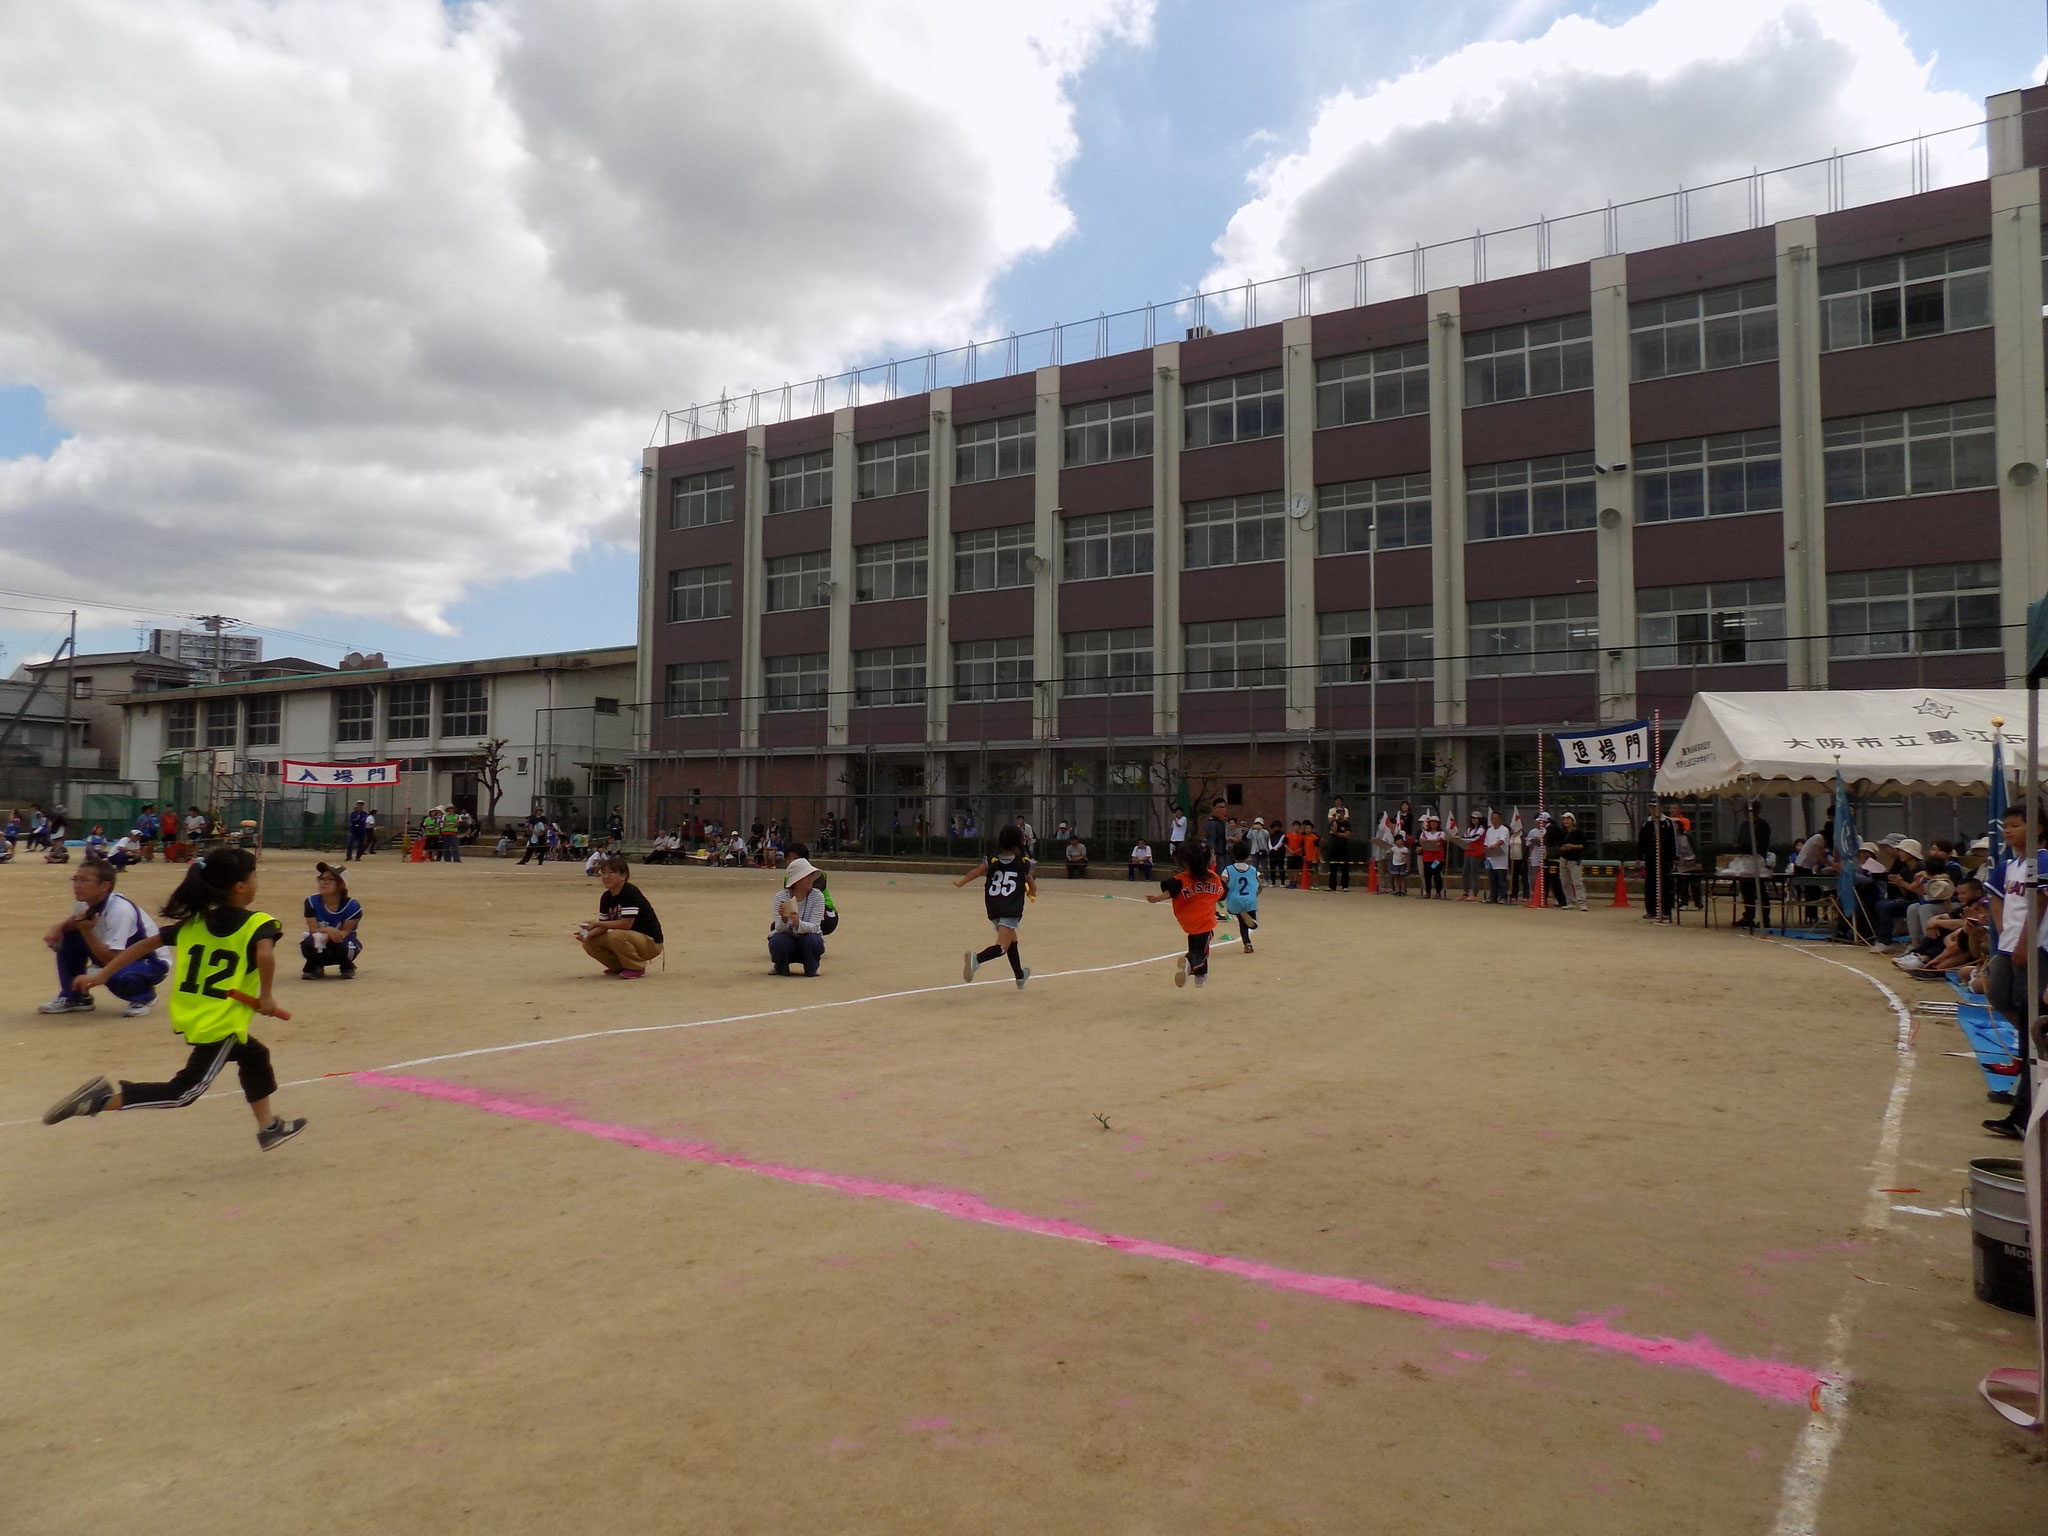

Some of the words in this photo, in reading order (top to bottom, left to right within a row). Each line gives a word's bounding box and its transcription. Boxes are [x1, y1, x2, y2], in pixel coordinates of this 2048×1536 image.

[1572, 733, 1641, 764] 退場門
[298, 768, 386, 783] 入場門
[988, 870, 1018, 897] 35
[1238, 876, 1249, 897] 2
[179, 943, 241, 1000] 12
